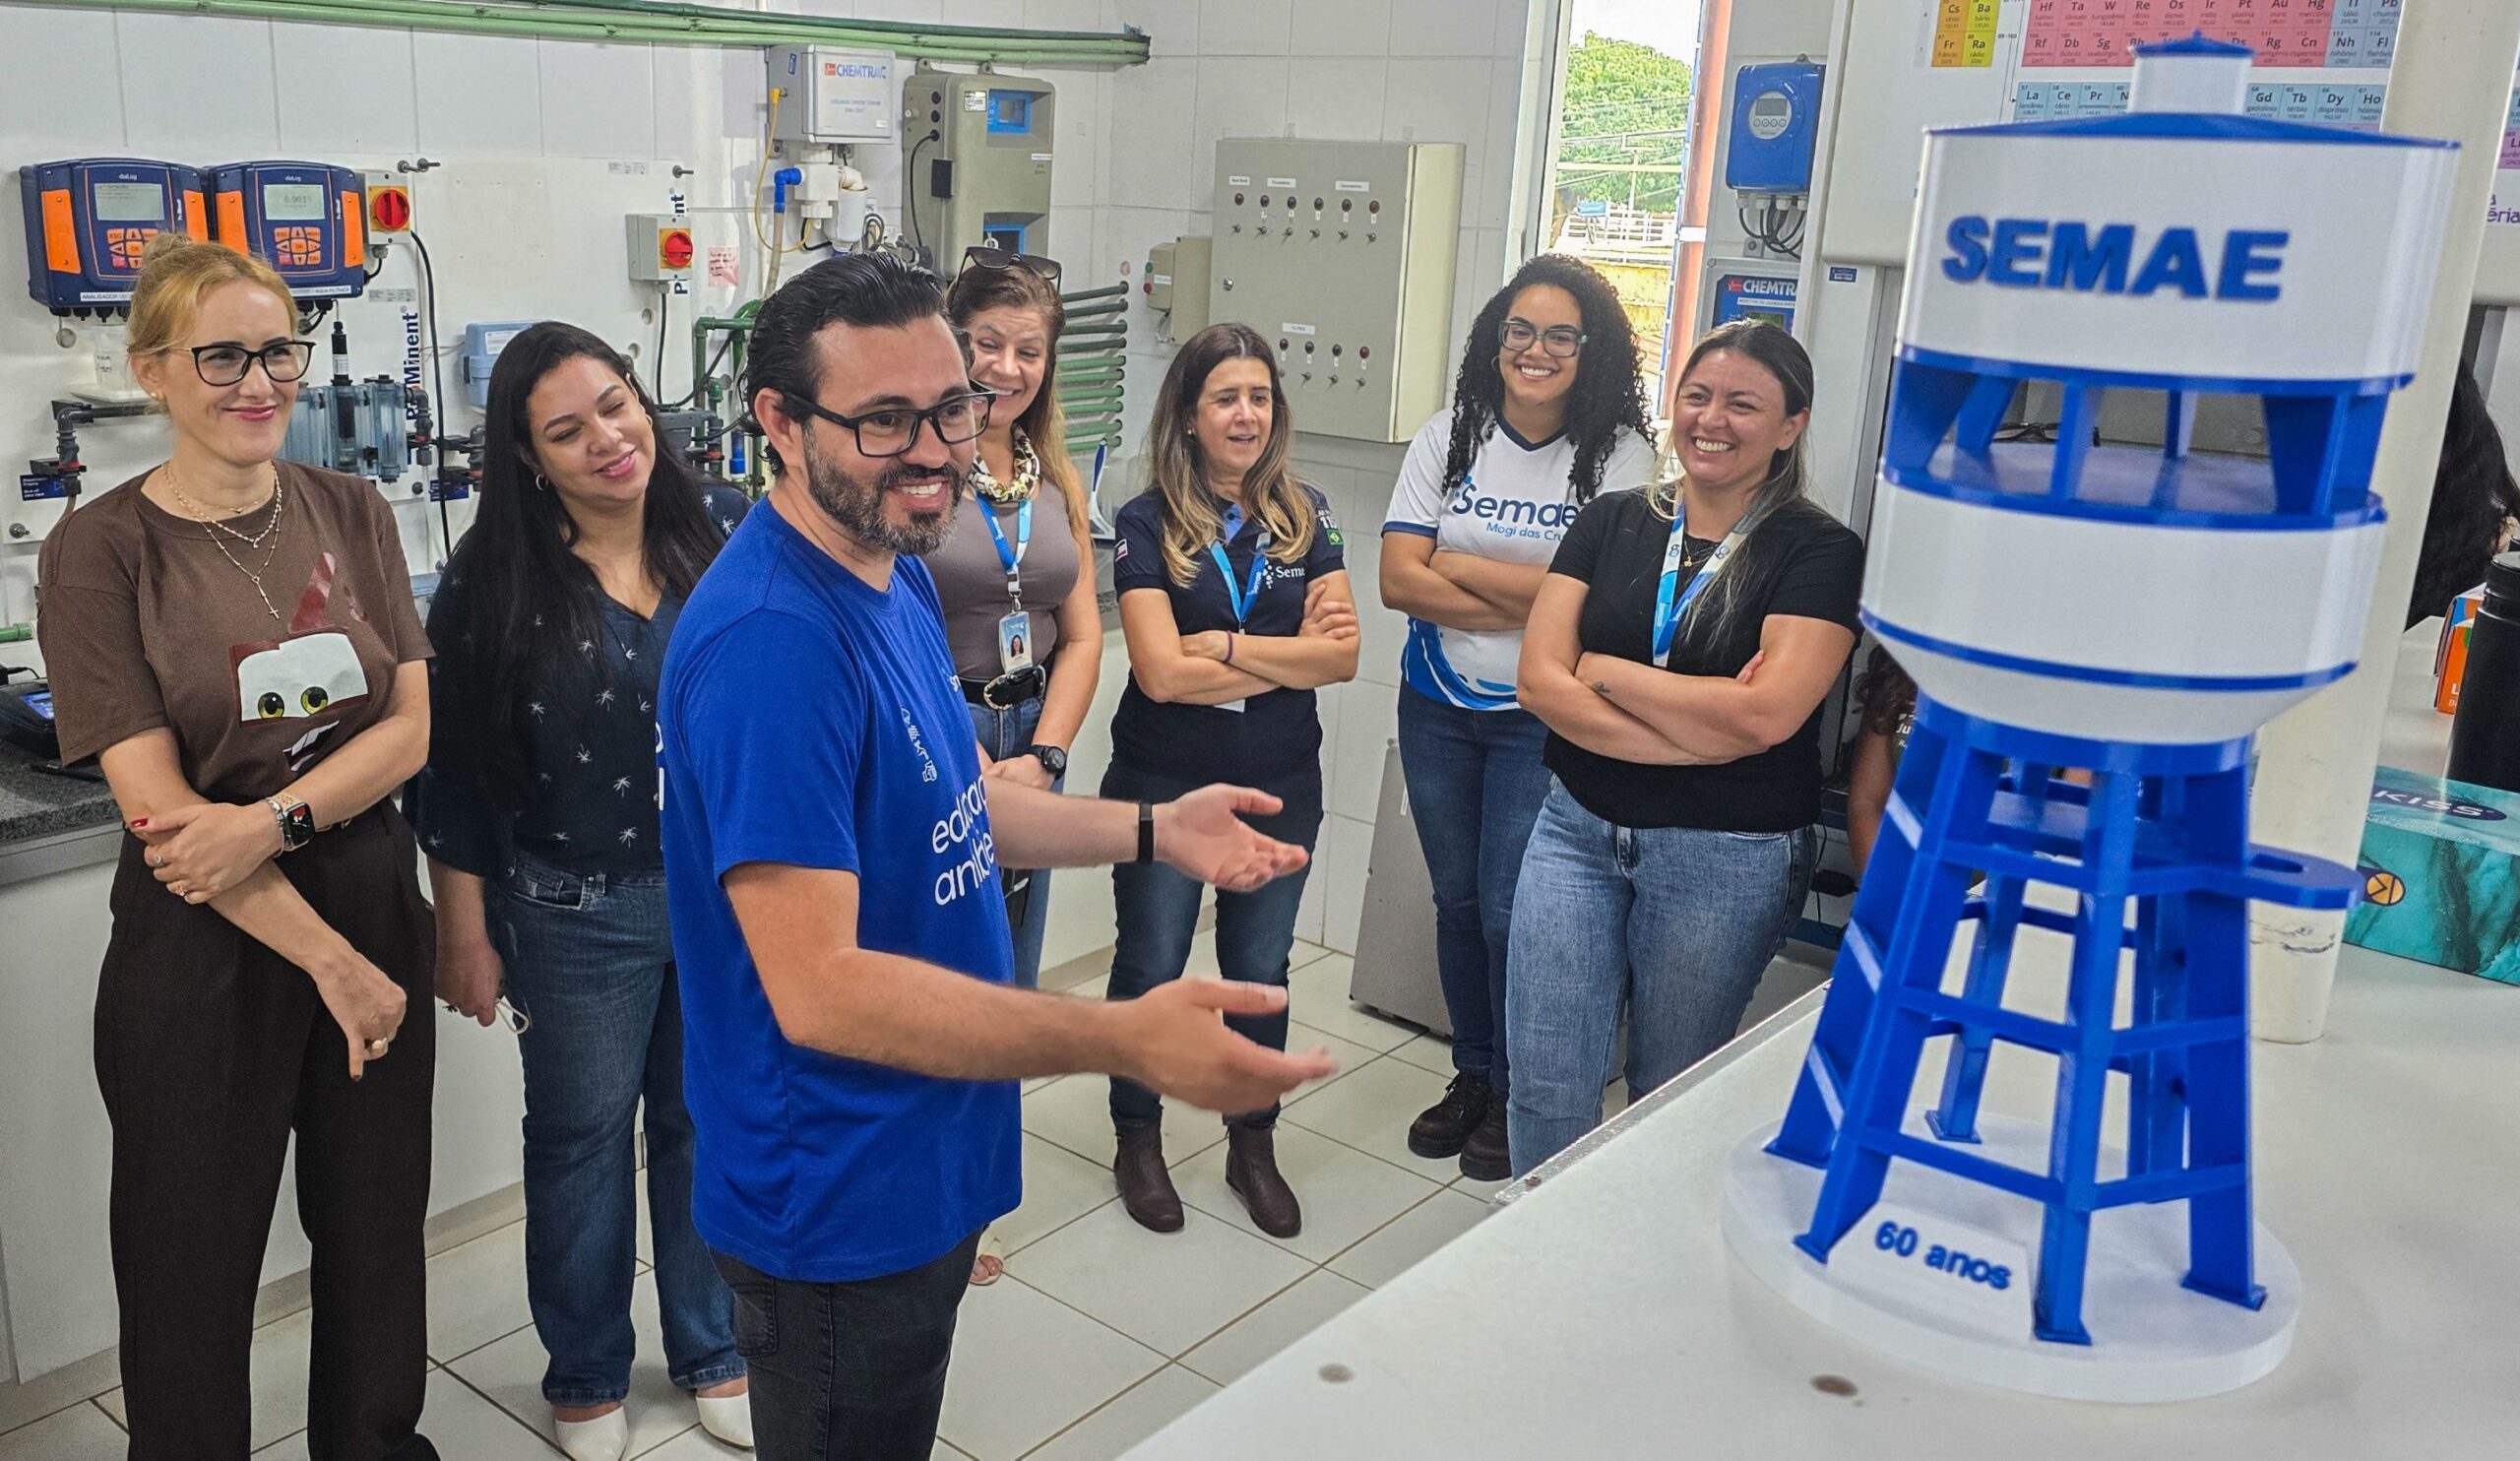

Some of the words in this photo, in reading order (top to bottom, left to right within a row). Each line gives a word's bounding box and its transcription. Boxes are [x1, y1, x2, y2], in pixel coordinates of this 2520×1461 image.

[1948, 4, 1960, 14] Cs
[1978, 3, 1991, 13] Ba
[2040, 2, 2053, 11] Hf
[2071, 2, 2084, 11] Ta
[2105, 1, 2116, 10] W
[2135, 1, 2150, 10] Re
[2169, 0, 2184, 9] Os
[2035, 38, 2048, 47] Rf
[2064, 38, 2079, 47] Db
[2097, 38, 2110, 50] Sg
[2266, 37, 2282, 49] Rg
[2300, 37, 2317, 47] Cn
[2336, 36, 2355, 47] Nh
[2377, 36, 2389, 47] Fl
[837, 64, 886, 79] CHEMTRAC
[2026, 91, 2039, 99] La
[2057, 91, 2071, 100] Ce
[2090, 92, 2103, 100] Pr
[2119, 92, 2129, 100] N
[2255, 93, 2272, 101] Gd
[2292, 93, 2306, 102] Tb
[2327, 94, 2344, 105] Dy
[2363, 94, 2381, 103] Ho
[1941, 215, 2290, 302] SEMAE
[403, 312, 421, 420] PrMinent
[1452, 482, 1579, 528] Semae
[1486, 522, 1517, 538] Mogi
[1519, 528, 1541, 539] das
[2374, 791, 2484, 816] KISS
[1875, 1221, 1918, 1257] 60
[1924, 1244, 2011, 1290] anos
